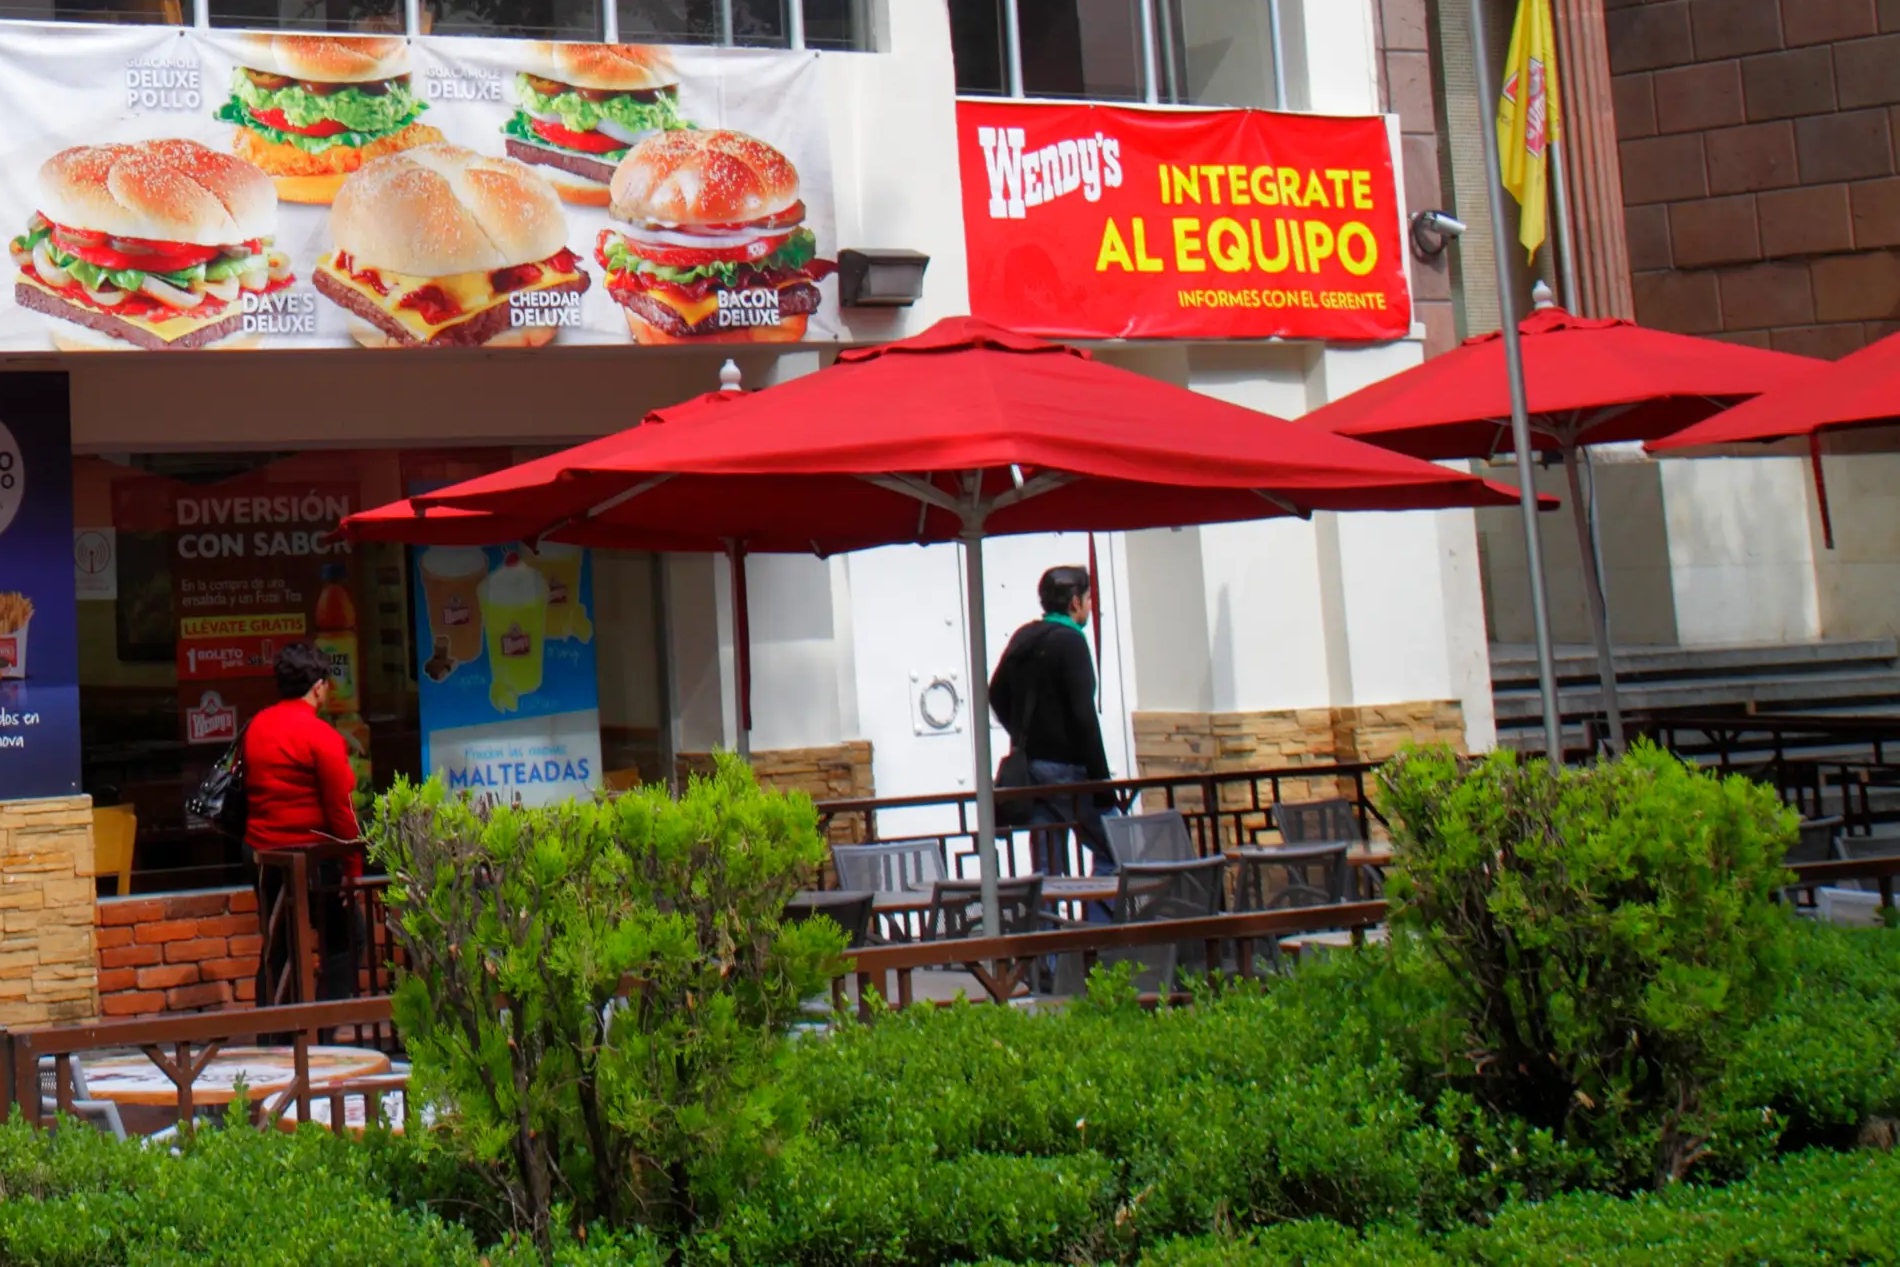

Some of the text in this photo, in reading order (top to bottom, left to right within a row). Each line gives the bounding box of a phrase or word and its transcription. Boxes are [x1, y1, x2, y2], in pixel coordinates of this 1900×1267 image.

[127, 58, 199, 69] GUACAMOLE
[127, 69, 200, 88] DELUXE
[128, 89, 201, 108] POLLO
[428, 79, 501, 100] DELUXE
[978, 126, 1122, 219] Wendy's
[1158, 164, 1374, 210] INTEGRATE
[1096, 216, 1378, 276] AL EQUIPO
[242, 291, 314, 313] DAVE'S
[508, 290, 581, 308] CHEDDAR
[717, 290, 779, 308] BACON
[1178, 289, 1387, 310] INFORMES CON EL GERENTE
[243, 314, 315, 332] DELUXE
[510, 308, 581, 327] DELUXE
[718, 308, 780, 327] DELUXE
[176, 489, 350, 526] DIVERSIÓN
[177, 533, 244, 559] CON
[181, 579, 196, 592] En
[251, 577, 266, 589] de
[229, 595, 237, 607] y
[184, 618, 246, 635] LLÉVATE
[186, 648, 197, 673] 1
[197, 647, 244, 660] BOLETO
[23, 712, 40, 725] en
[450, 758, 589, 789] MALTEADAS
